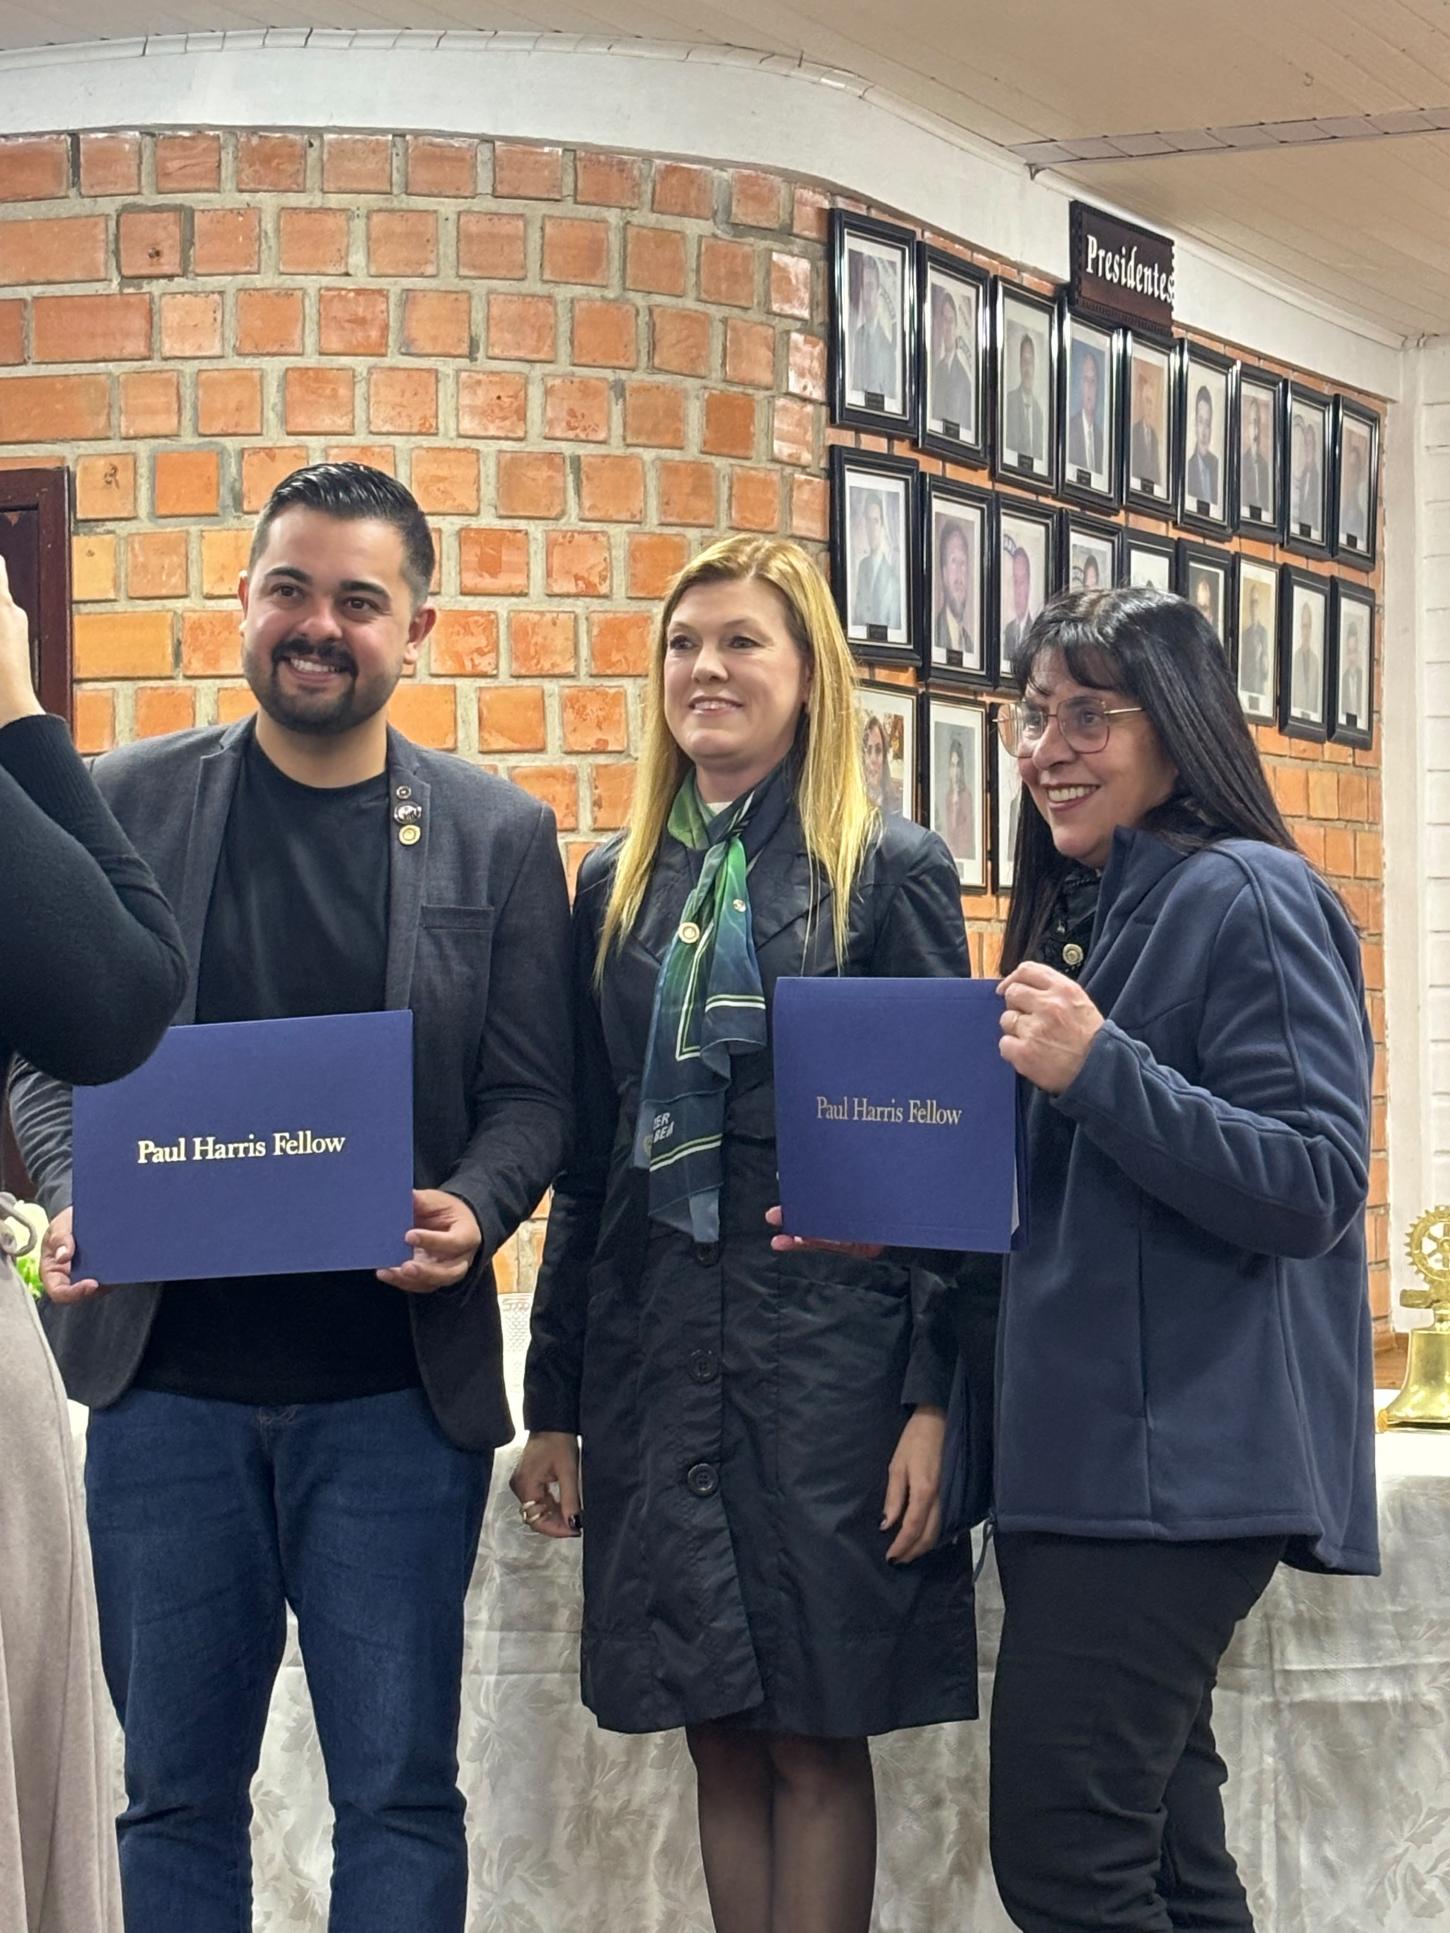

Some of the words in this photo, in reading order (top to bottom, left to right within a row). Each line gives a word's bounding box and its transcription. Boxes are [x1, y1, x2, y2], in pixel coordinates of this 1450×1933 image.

[1086, 234, 1175, 303] Presidentes
[816, 1095, 849, 1120] Paul
[852, 1097, 904, 1123] Harris
[907, 1099, 963, 1126] Fellow
[137, 1137, 187, 1164] Paul
[192, 1133, 267, 1161] Harris
[272, 1130, 347, 1156] Fellow
